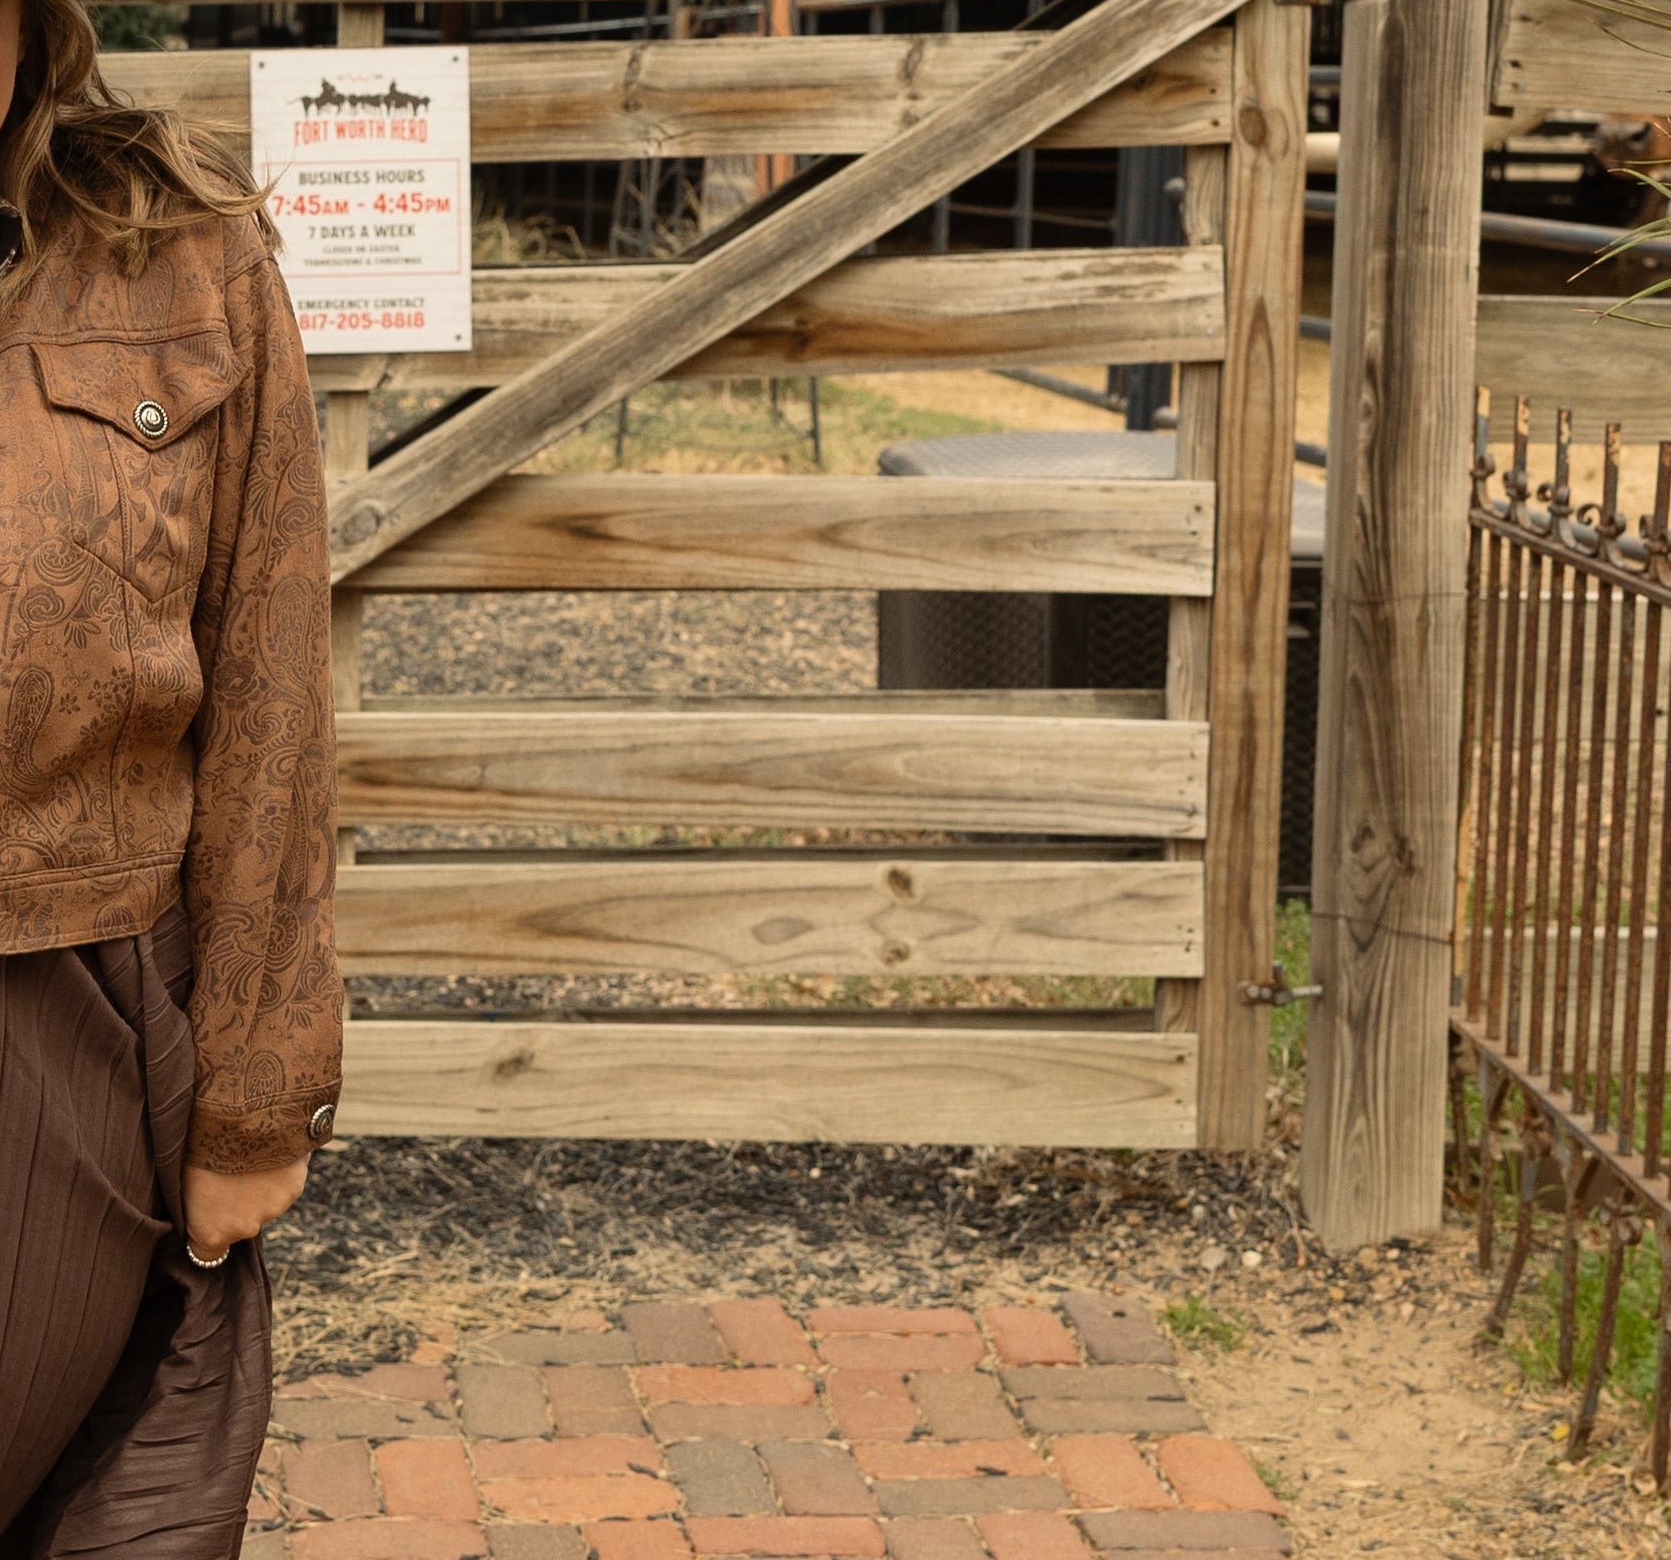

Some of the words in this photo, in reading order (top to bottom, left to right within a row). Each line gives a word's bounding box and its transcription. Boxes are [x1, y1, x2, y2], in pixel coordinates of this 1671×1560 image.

[293, 120, 329, 146] FORT
[334, 119, 386, 140] WORTH
[391, 118, 428, 144] HERD
[298, 171, 371, 186] BUSINESS
[375, 169, 426, 184] HOURS
[272, 194, 349, 216] 7:45AM
[373, 191, 451, 214] 4:45PM
[308, 226, 316, 240] 7
[320, 225, 355, 239] DAYS
[360, 224, 369, 238] A
[374, 223, 416, 238] WEEK
[298, 299, 369, 310] EMERGENCY
[373, 297, 425, 309] CONTACT
[299, 311, 426, 330] 817-205-8818
